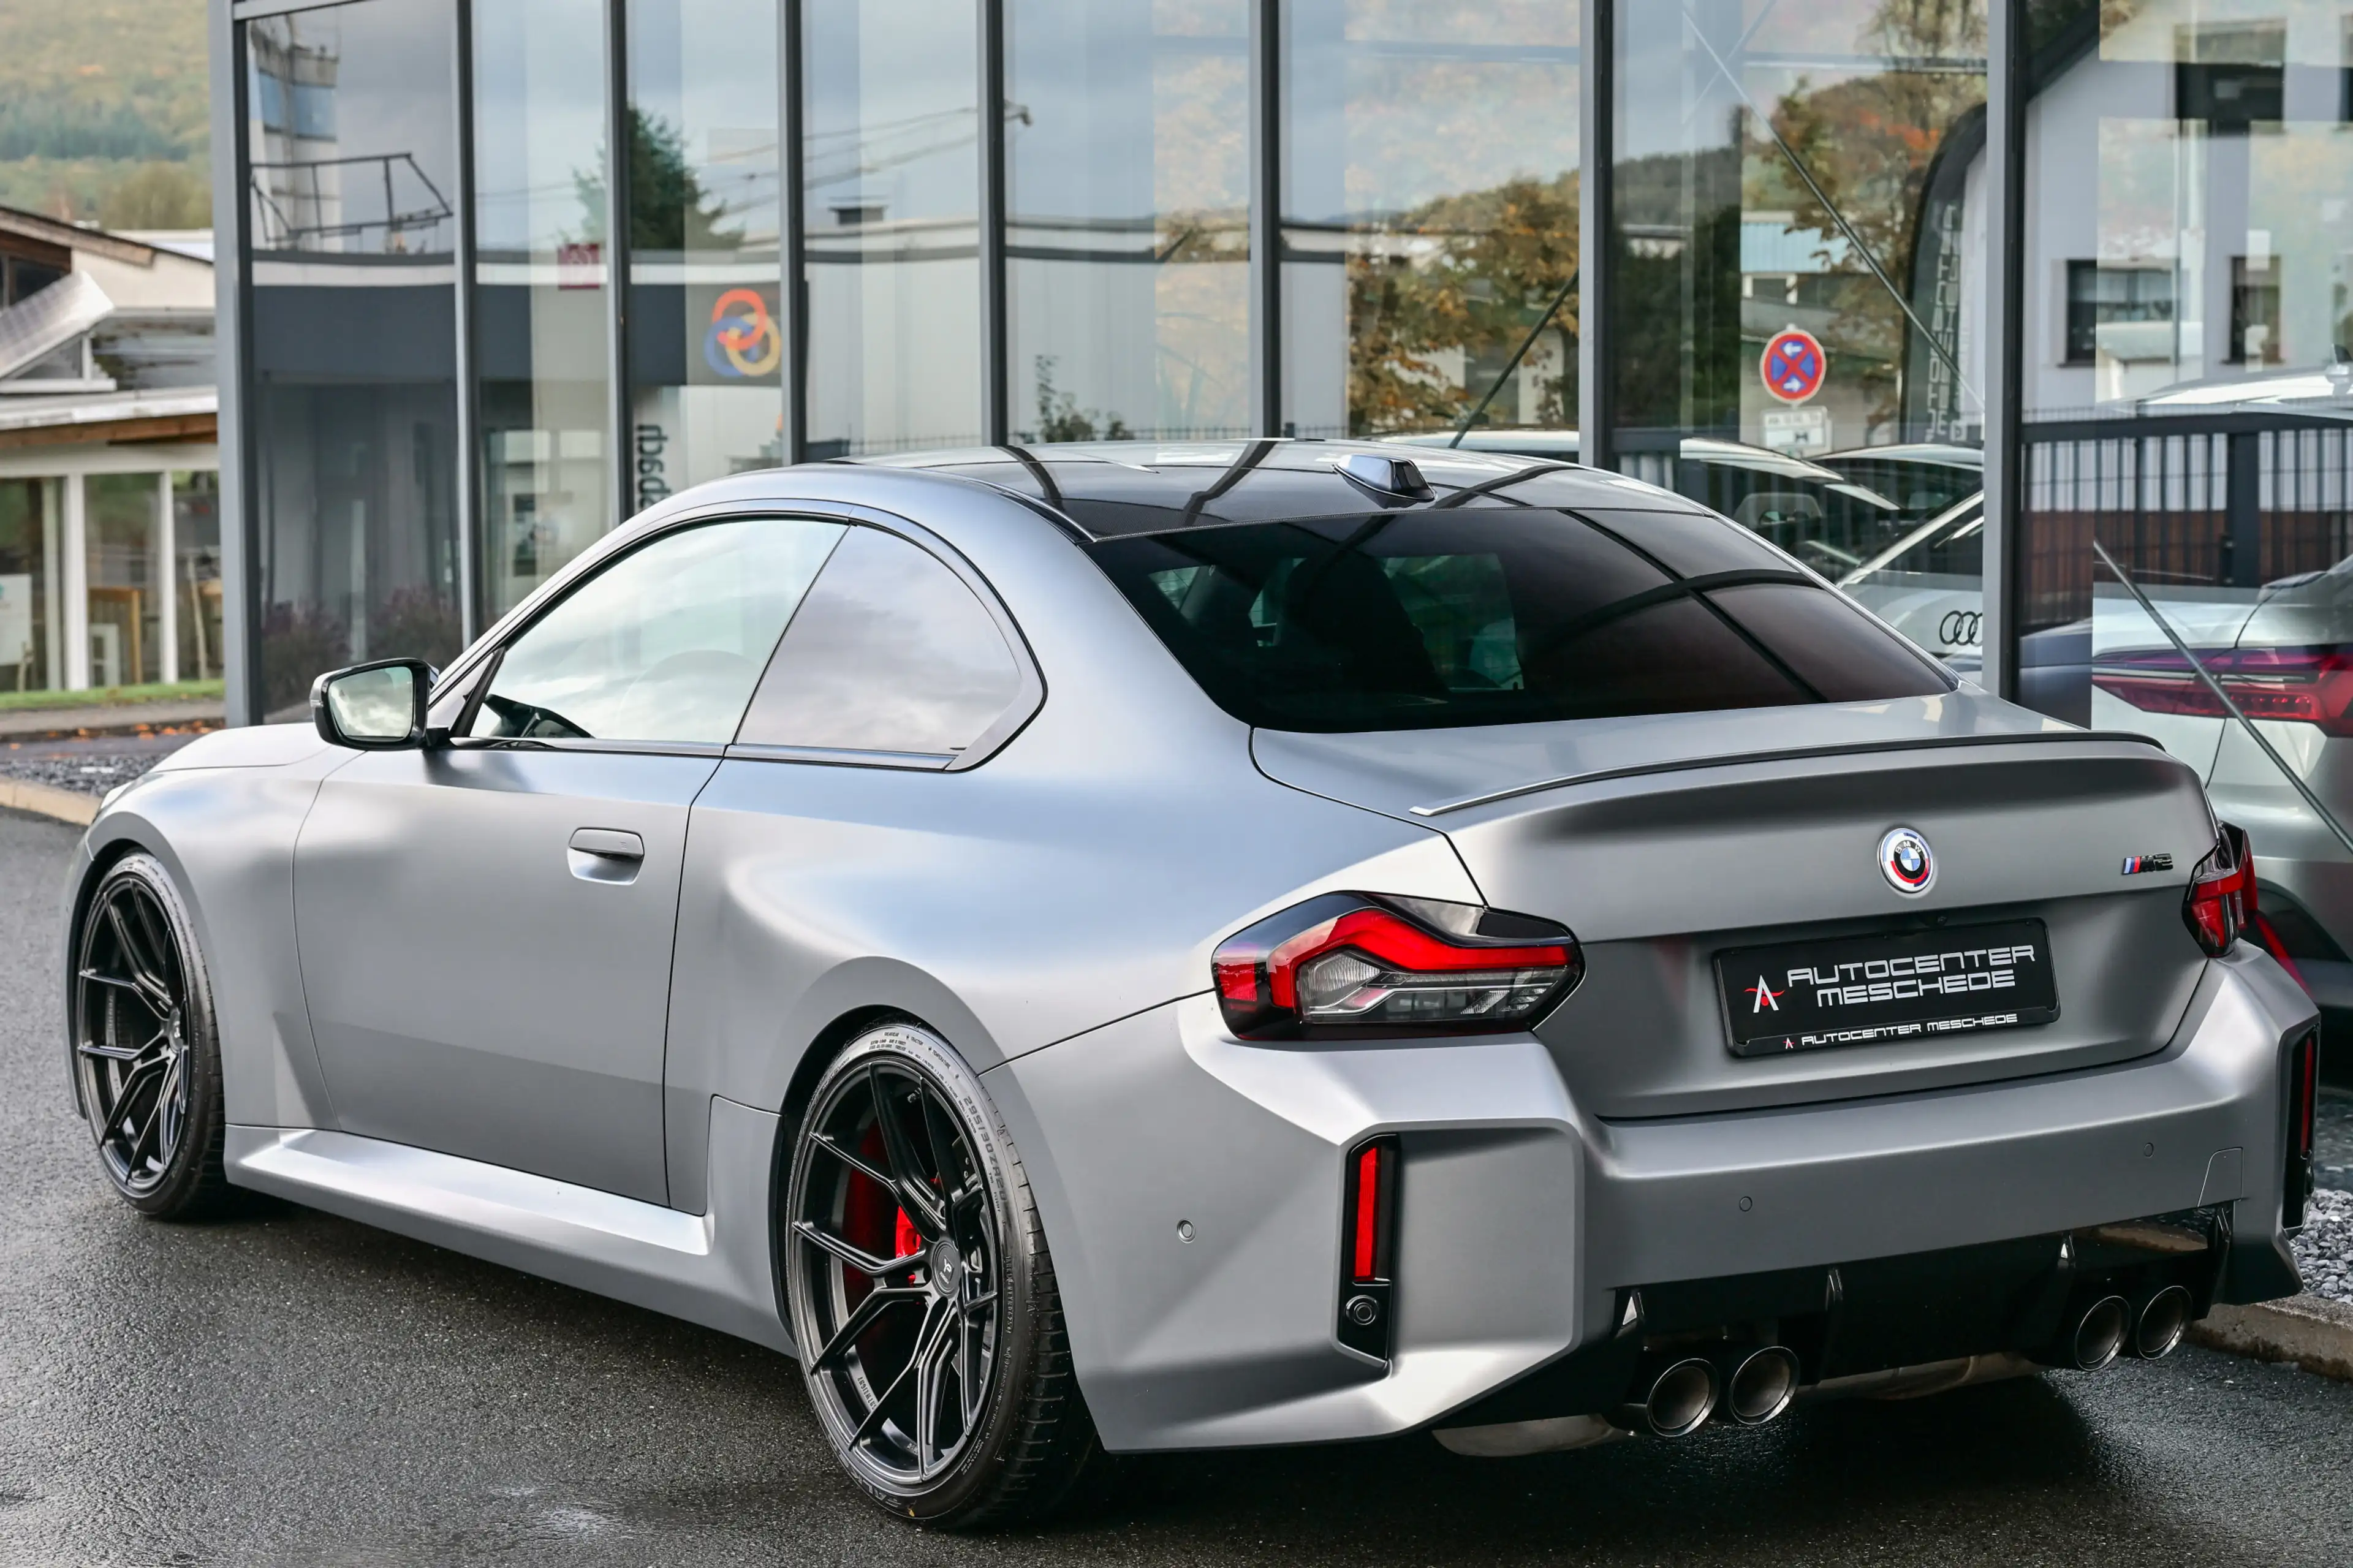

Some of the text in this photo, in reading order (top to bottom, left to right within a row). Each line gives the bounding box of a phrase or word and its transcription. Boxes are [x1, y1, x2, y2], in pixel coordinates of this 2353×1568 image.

[1895, 840, 1922, 854] BMW
[2139, 852, 2173, 873] M2
[1787, 945, 2035, 987] AUTOCENTER
[1817, 969, 2015, 1007] MESCHEDE
[1802, 1013, 2017, 1045] AUTOCENTER MESCHEDE
